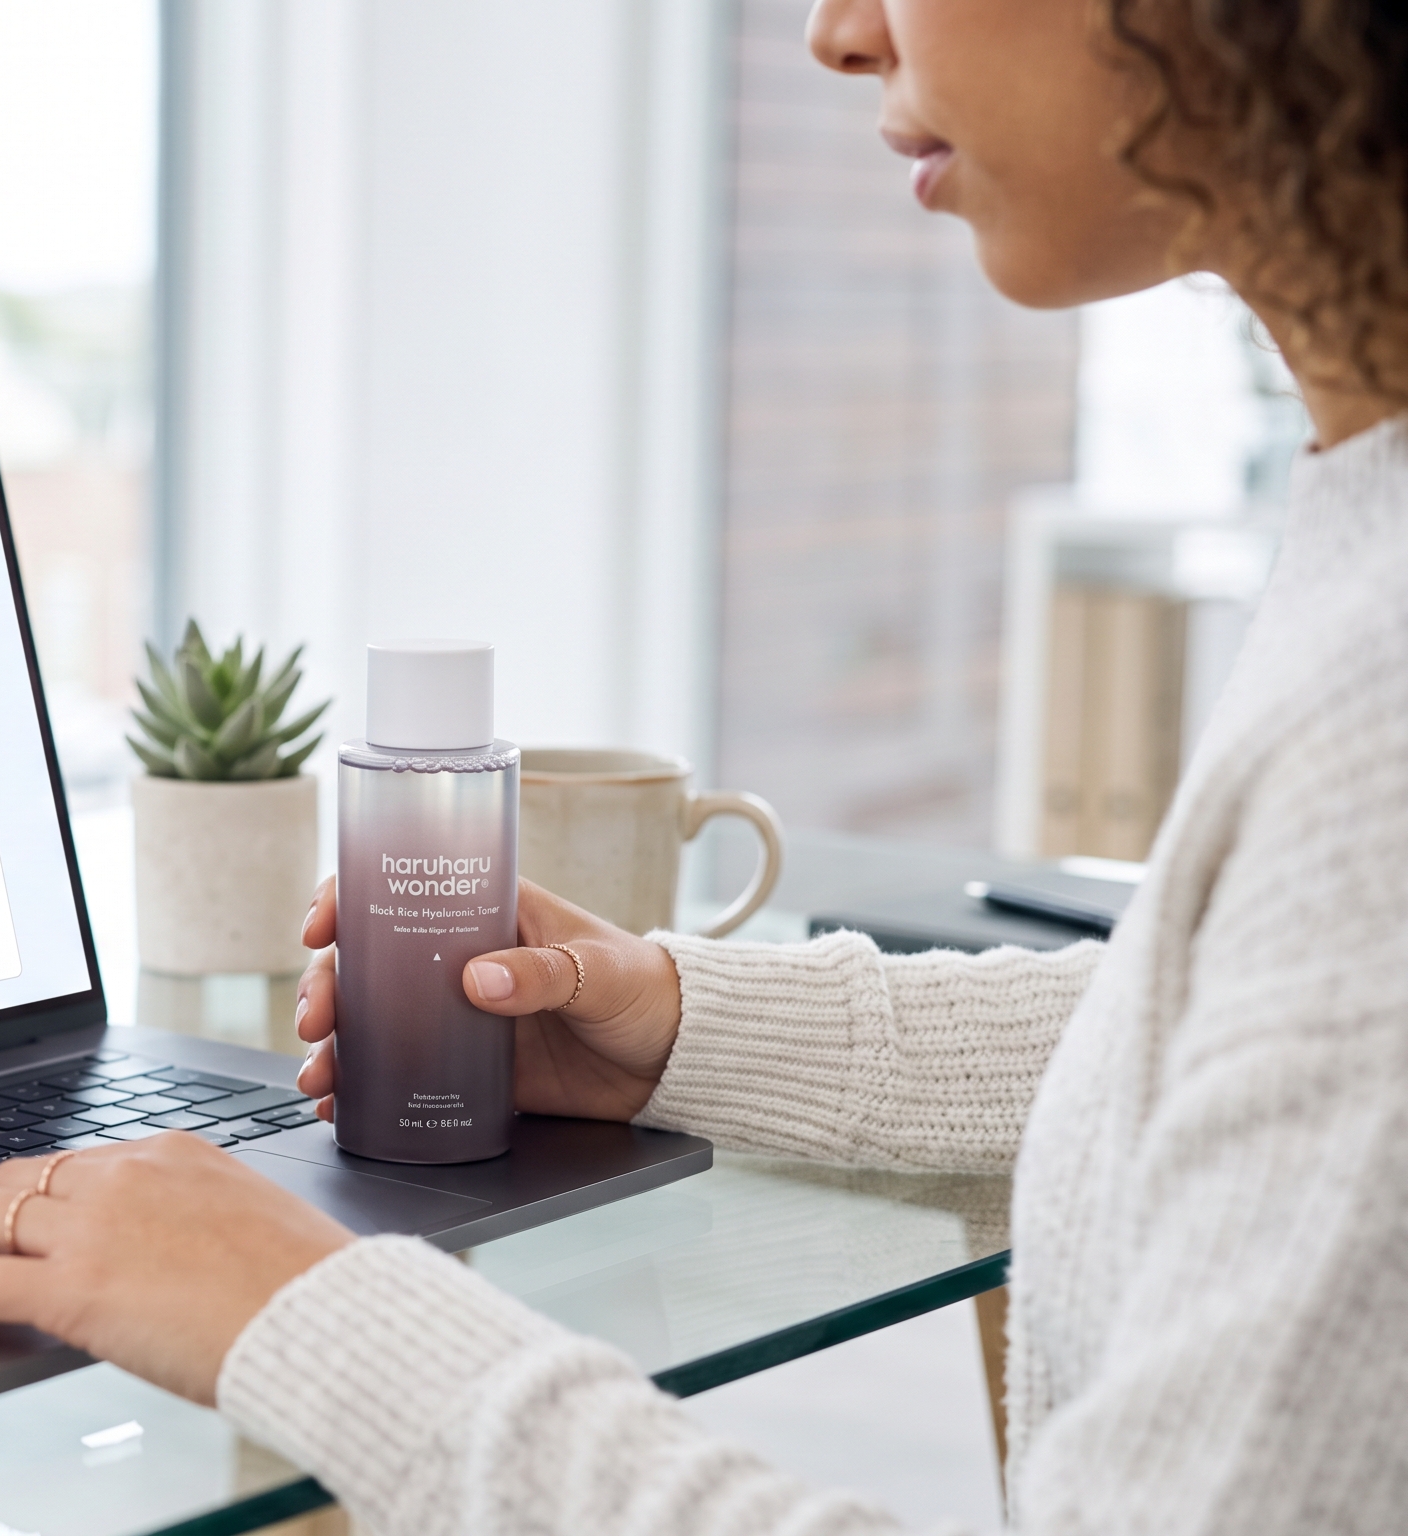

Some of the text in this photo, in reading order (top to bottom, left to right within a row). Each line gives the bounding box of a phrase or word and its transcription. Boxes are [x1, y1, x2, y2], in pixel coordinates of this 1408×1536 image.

[382, 853, 491, 875] haruharu
[397, 907, 419, 918] Rice
[422, 907, 475, 920] Hyaluronic
[477, 906, 500, 915] Toner
